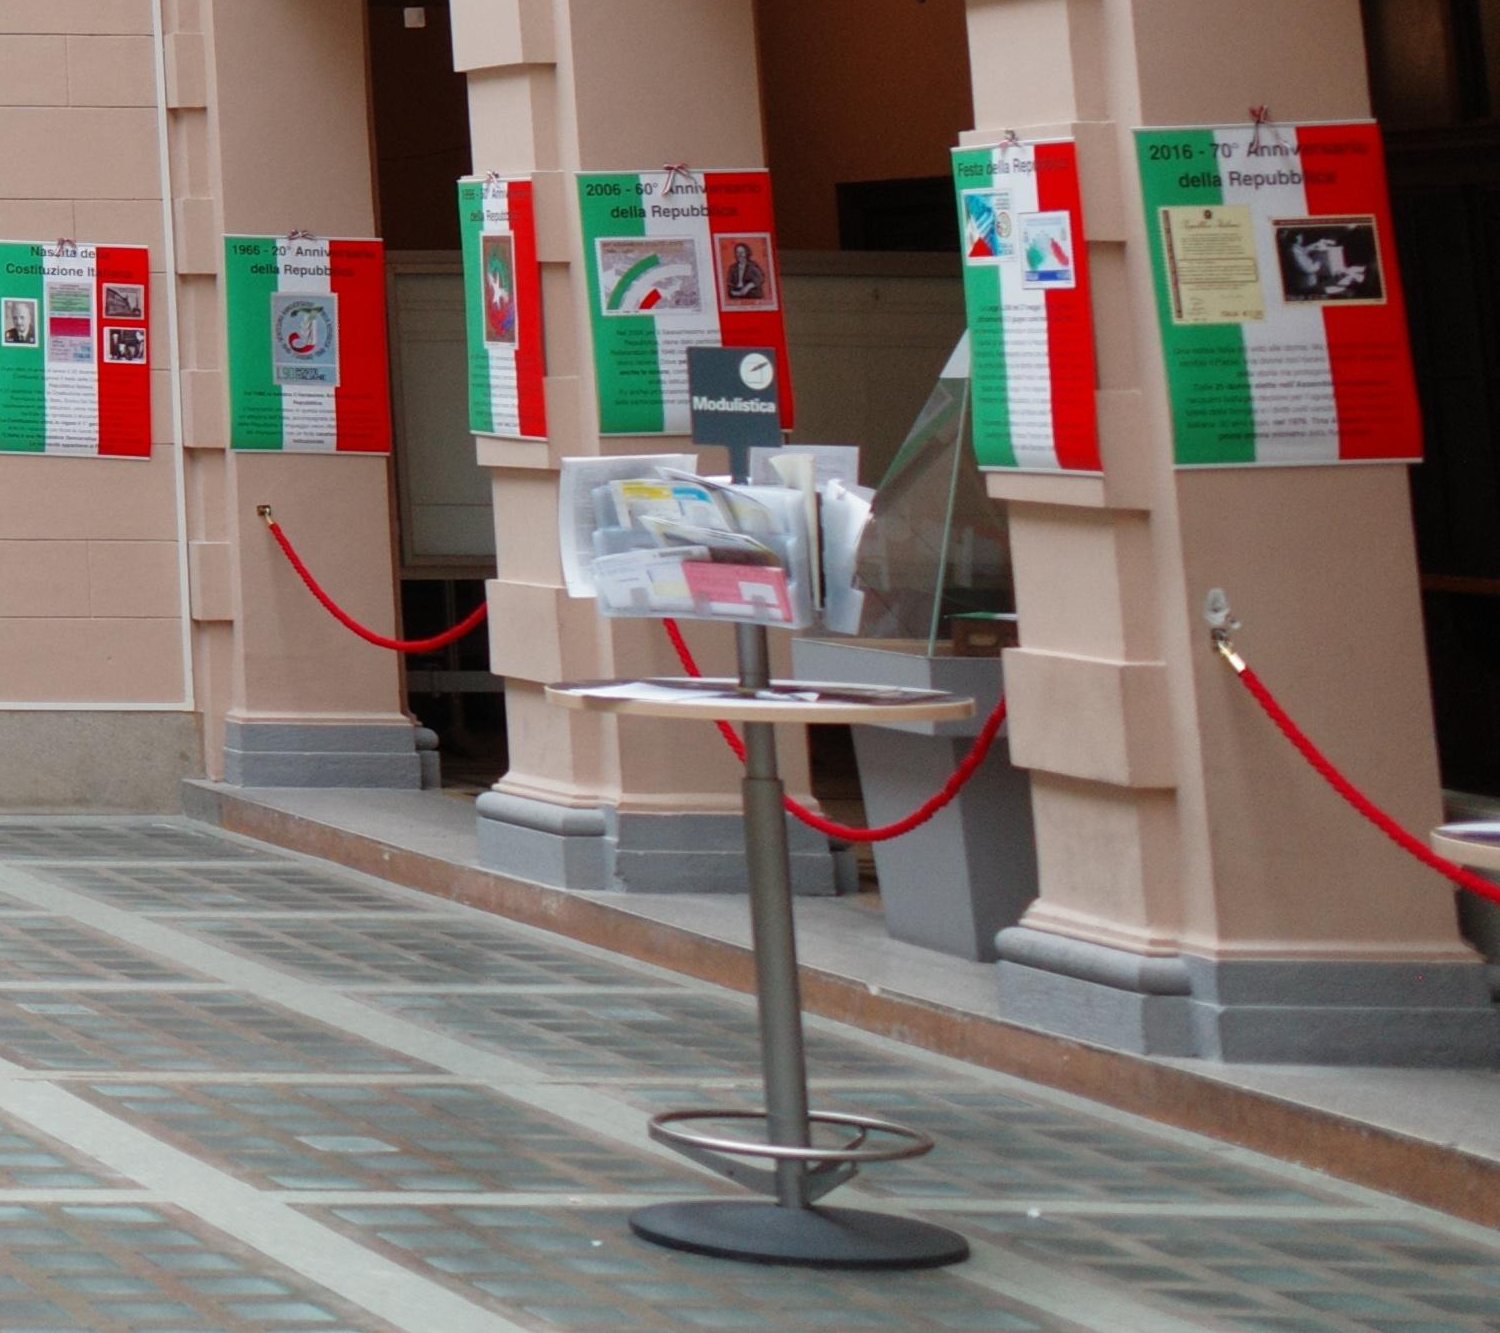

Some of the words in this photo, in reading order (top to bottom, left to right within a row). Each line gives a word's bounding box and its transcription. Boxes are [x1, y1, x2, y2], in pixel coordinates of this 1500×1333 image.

[1149, 144, 1193, 161] 2016
[1212, 142, 1239, 159] 70°
[1246, 139, 1368, 159] Anniversario
[958, 163, 984, 177] Festa
[986, 160, 1010, 174] della
[1179, 171, 1223, 188] della
[1229, 170, 1336, 190] Repubblica
[586, 183, 622, 196] 2006
[635, 182, 659, 196] 60°
[611, 205, 646, 219] della
[652, 205, 737, 221] Repubblica
[30, 245, 77, 258] Nascita
[6, 262, 83, 277] Costituzione
[250, 263, 279, 275] della
[692, 396, 776, 413] Modulistica
